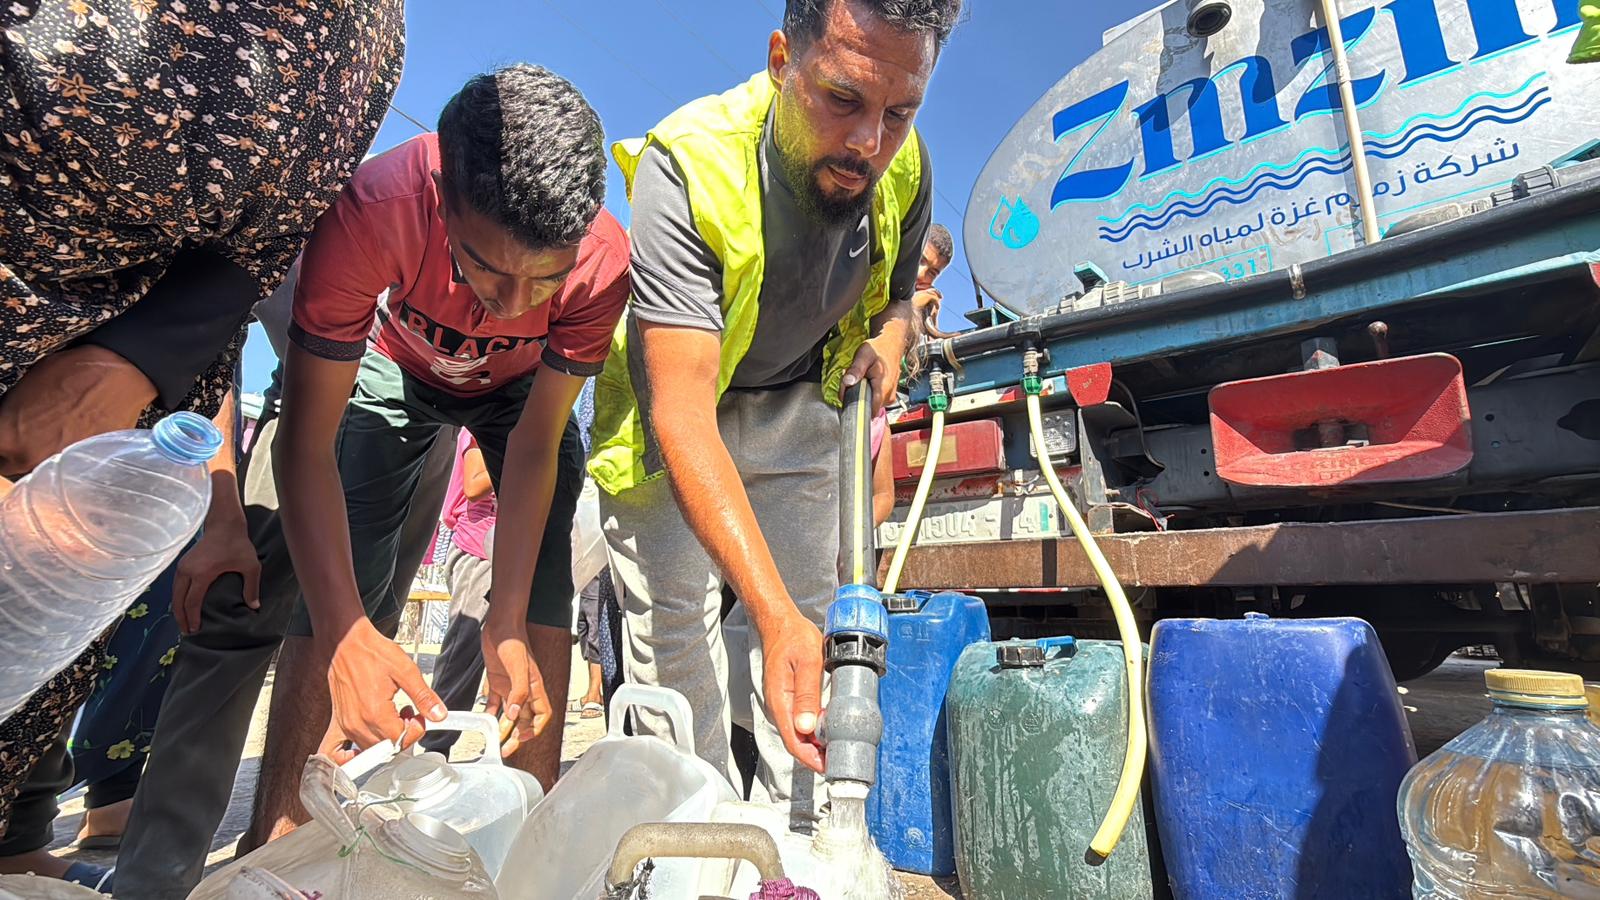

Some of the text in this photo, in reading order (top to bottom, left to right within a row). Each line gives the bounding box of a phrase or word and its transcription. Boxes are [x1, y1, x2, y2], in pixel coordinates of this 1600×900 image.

[1413, 137, 1519, 183] شركة
[1200, 212, 1264, 247] لمياه
[1270, 196, 1321, 227] غزة
[1122, 234, 1194, 271] الشرب
